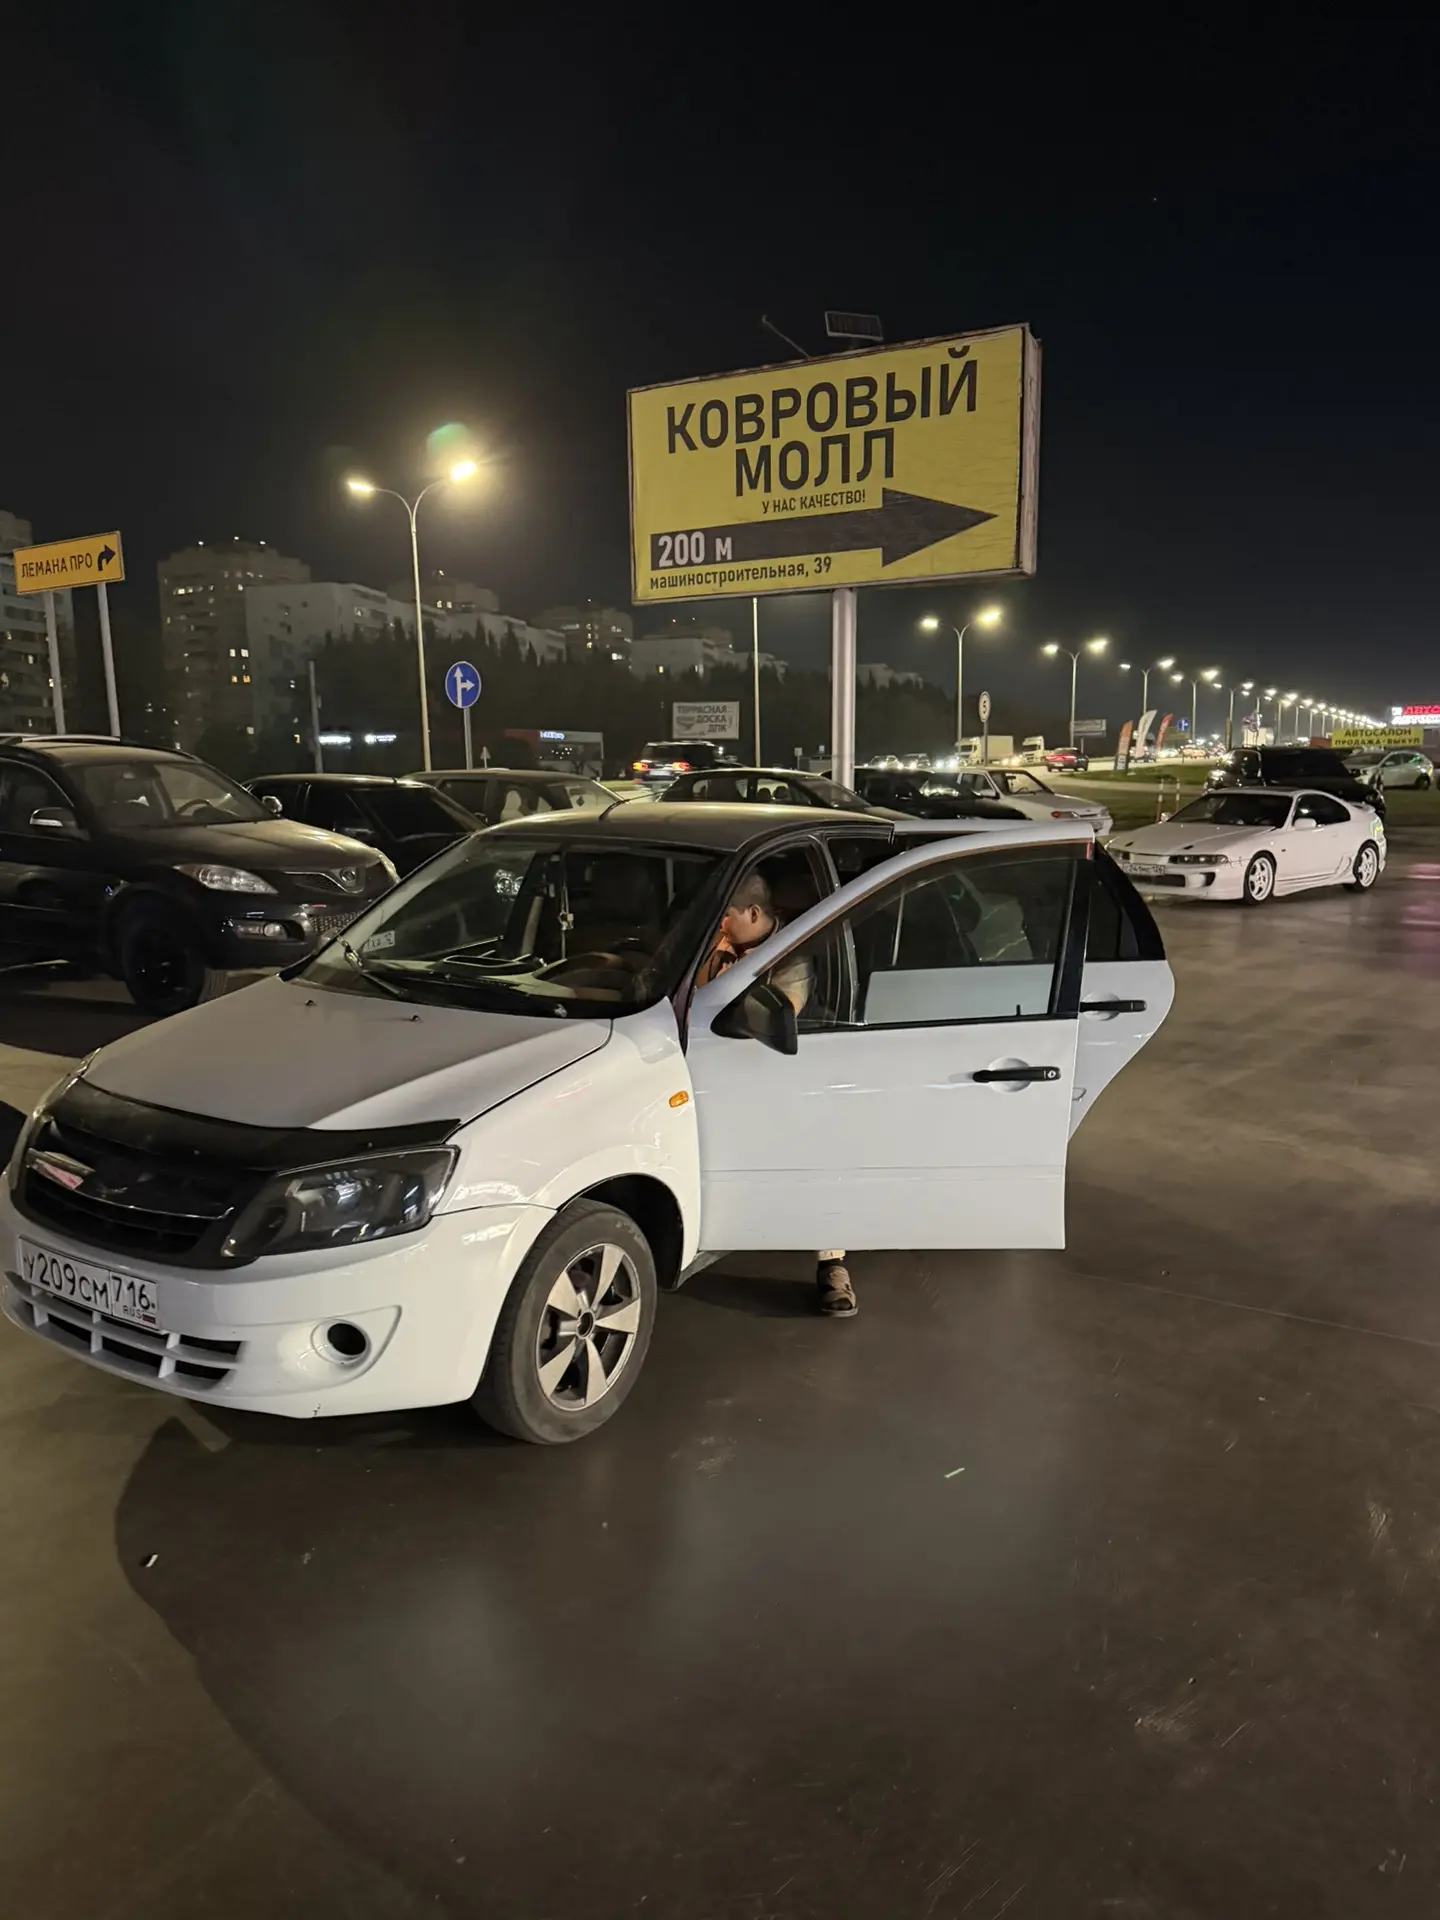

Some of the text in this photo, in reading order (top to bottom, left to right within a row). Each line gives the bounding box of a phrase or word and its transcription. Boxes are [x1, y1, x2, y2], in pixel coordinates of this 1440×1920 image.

[667, 344, 978, 454] КОВРОВЫЙ
[736, 427, 894, 497] МОЛЛ
[762, 490, 866, 514] У НАС КАЧЕСТВО!
[657, 532, 705, 567] 200
[22, 553, 92, 578] ЛЕМАНА ПРО
[650, 556, 831, 590] машиностроительная, 39
[982, 701, 988, 714] 5
[1345, 729, 1411, 737] АВТОСАЛОН
